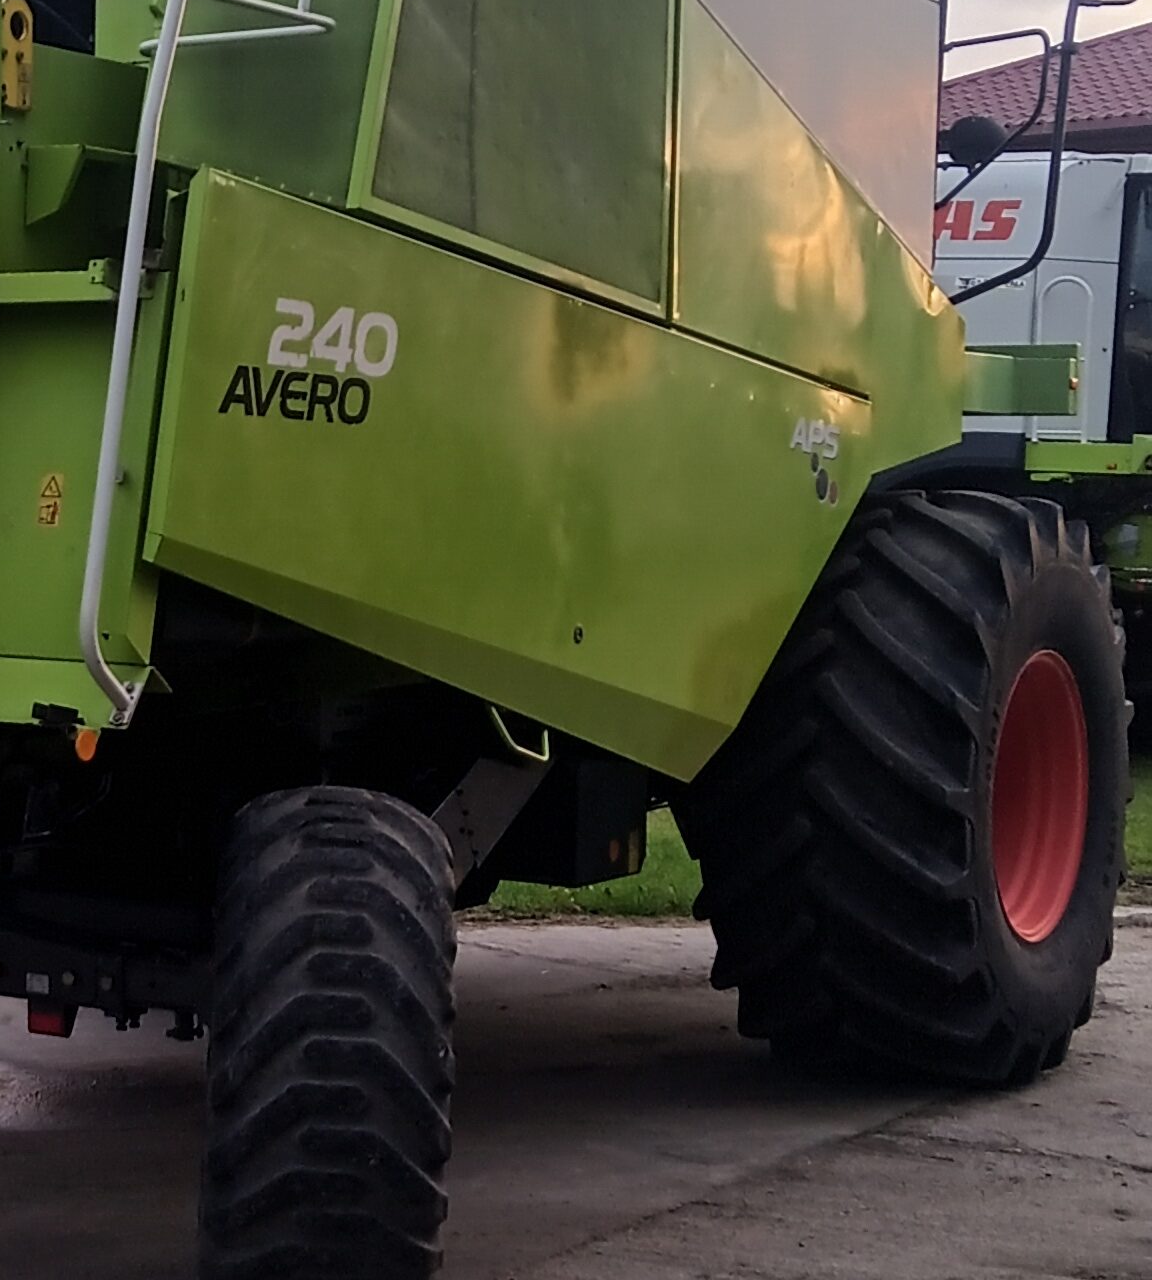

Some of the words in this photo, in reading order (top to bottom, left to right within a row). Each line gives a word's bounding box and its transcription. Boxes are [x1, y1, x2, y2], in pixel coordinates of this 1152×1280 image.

[267, 297, 398, 377] 240
[218, 365, 370, 425] AVERO
[790, 417, 840, 459] APS
